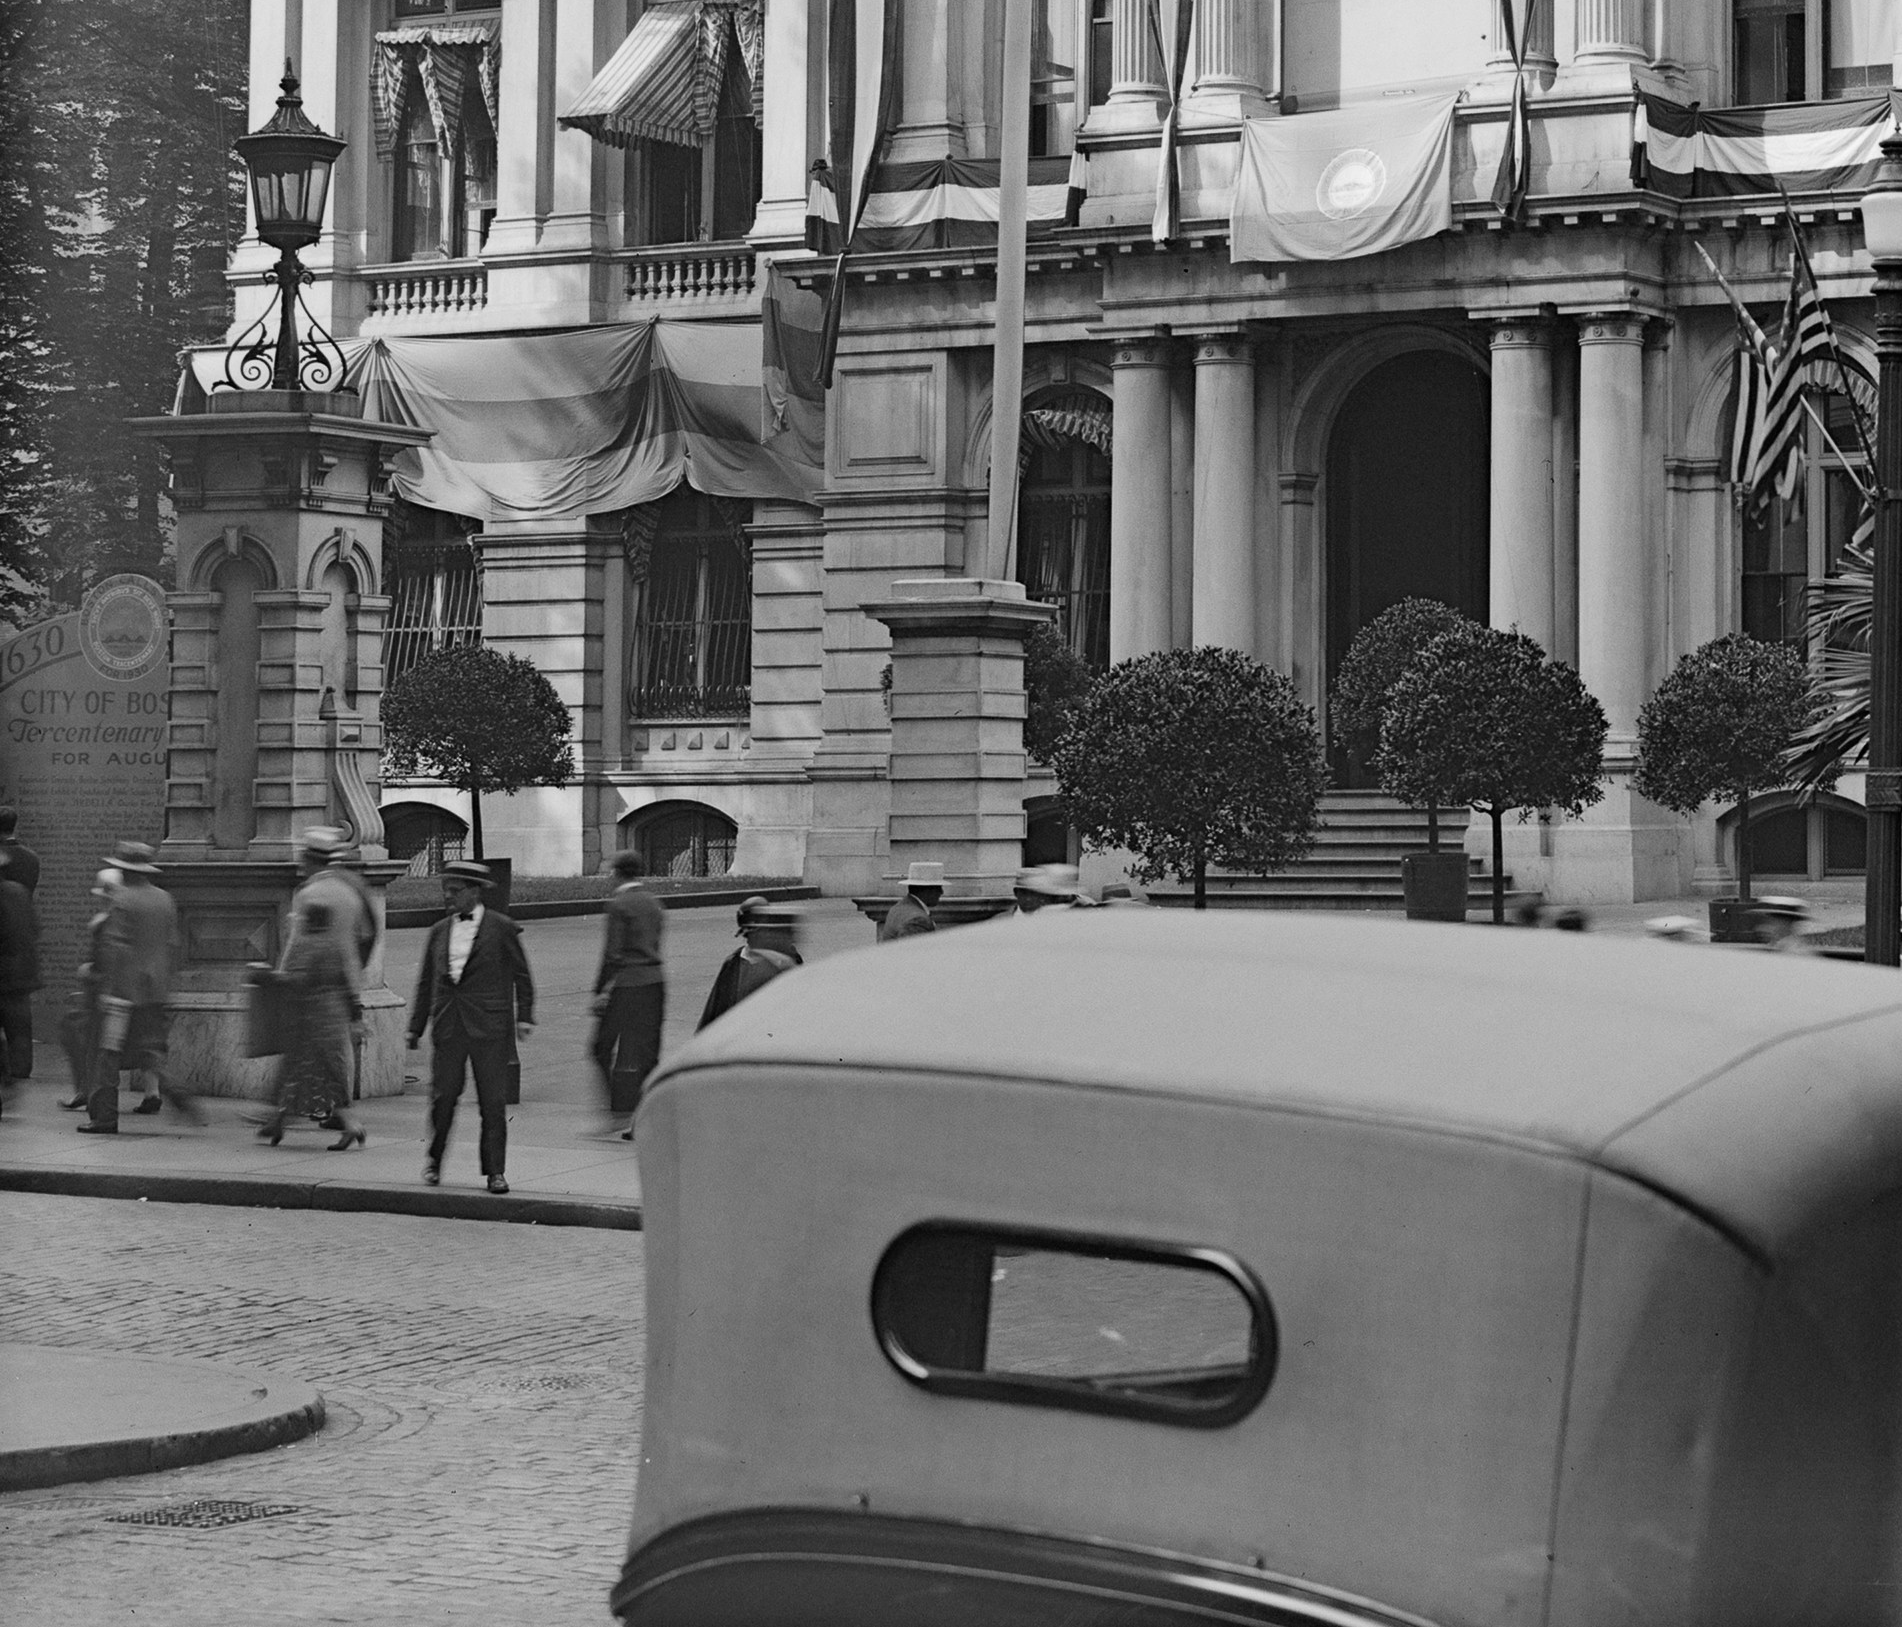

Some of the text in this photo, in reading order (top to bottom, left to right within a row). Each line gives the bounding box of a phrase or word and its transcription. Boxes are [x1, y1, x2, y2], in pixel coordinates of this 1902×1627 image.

[20, 689, 169, 715] CITY OF BOS
[7, 718, 165, 751] Tercentenary
[52, 752, 167, 765] FOR AUGU
